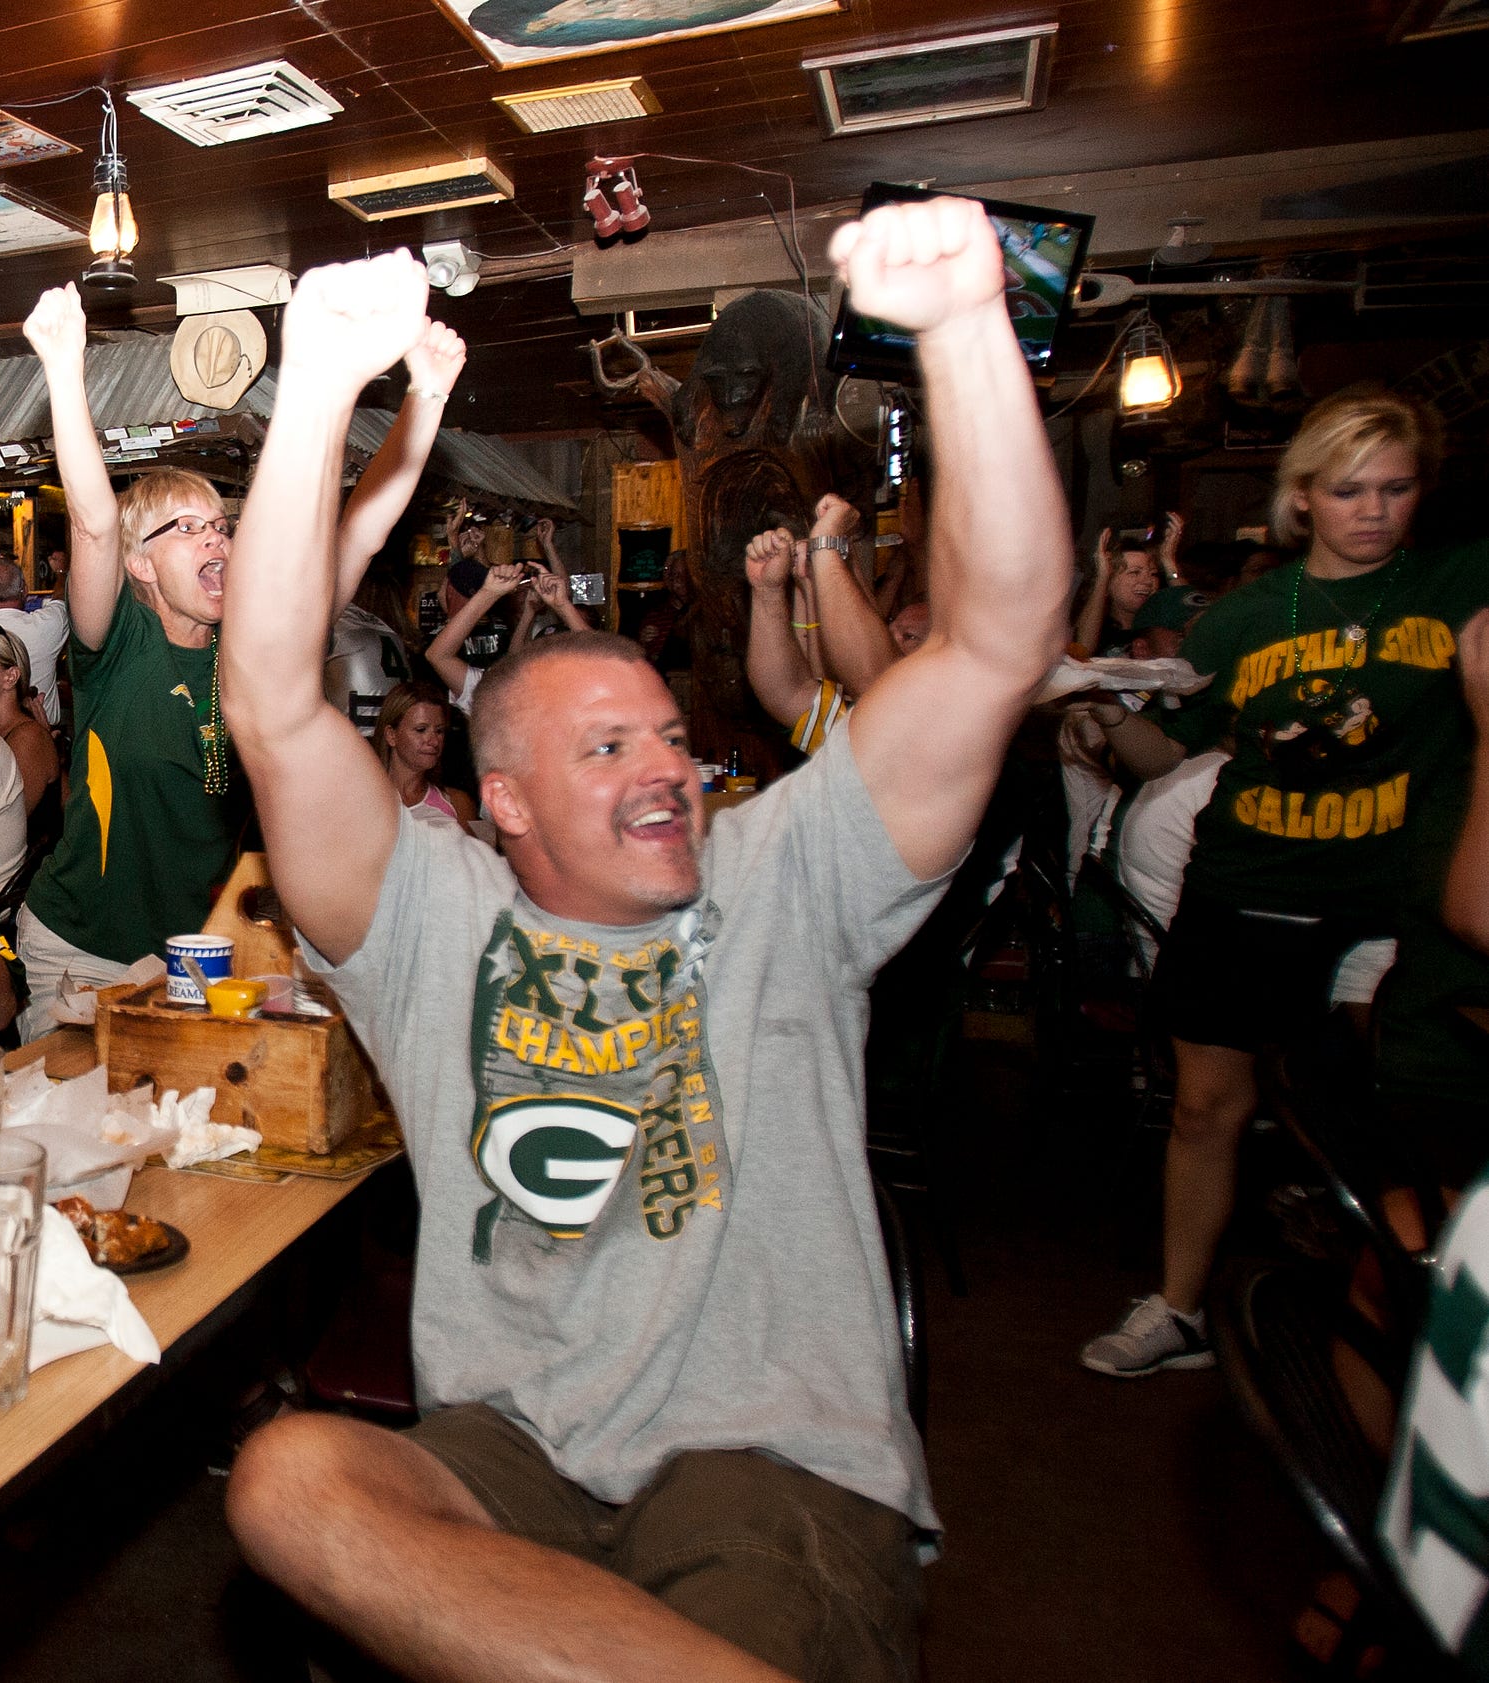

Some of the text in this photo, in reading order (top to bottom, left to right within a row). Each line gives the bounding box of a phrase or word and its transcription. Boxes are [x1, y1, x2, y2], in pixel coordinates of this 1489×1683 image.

[1229, 629, 1368, 711] BUFFALO
[1235, 772, 1411, 840] SALOON
[479, 1103, 639, 1228] G
[696, 1141, 724, 1212] BAY
